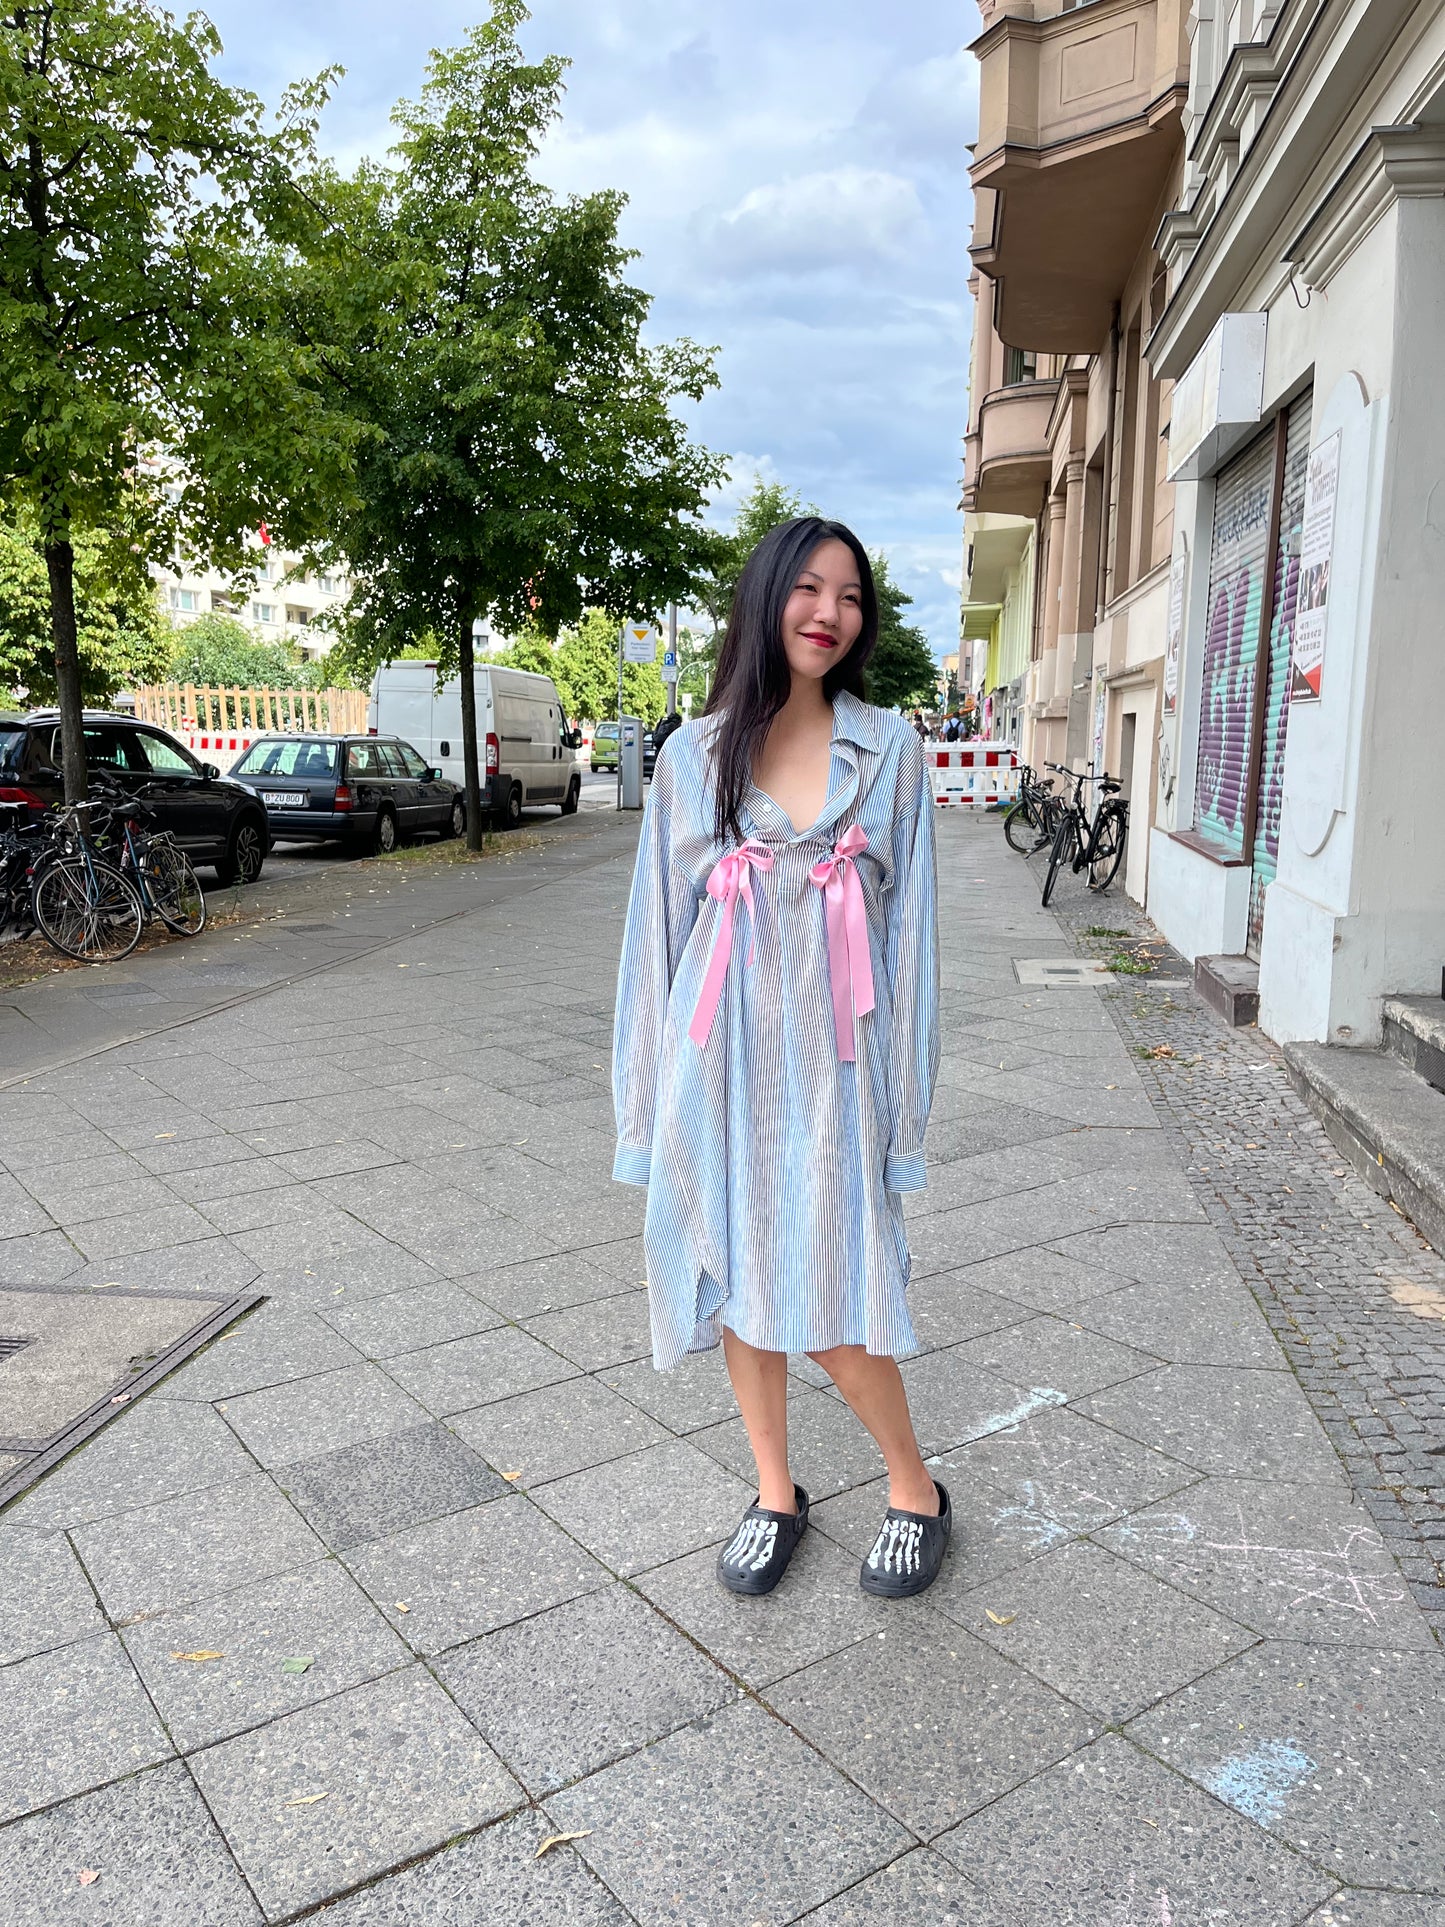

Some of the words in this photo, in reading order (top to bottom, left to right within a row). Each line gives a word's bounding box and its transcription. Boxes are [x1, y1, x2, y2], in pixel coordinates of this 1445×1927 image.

[665, 653, 672, 664] P
[265, 793, 270, 801] B
[274, 794, 285, 802] ZU
